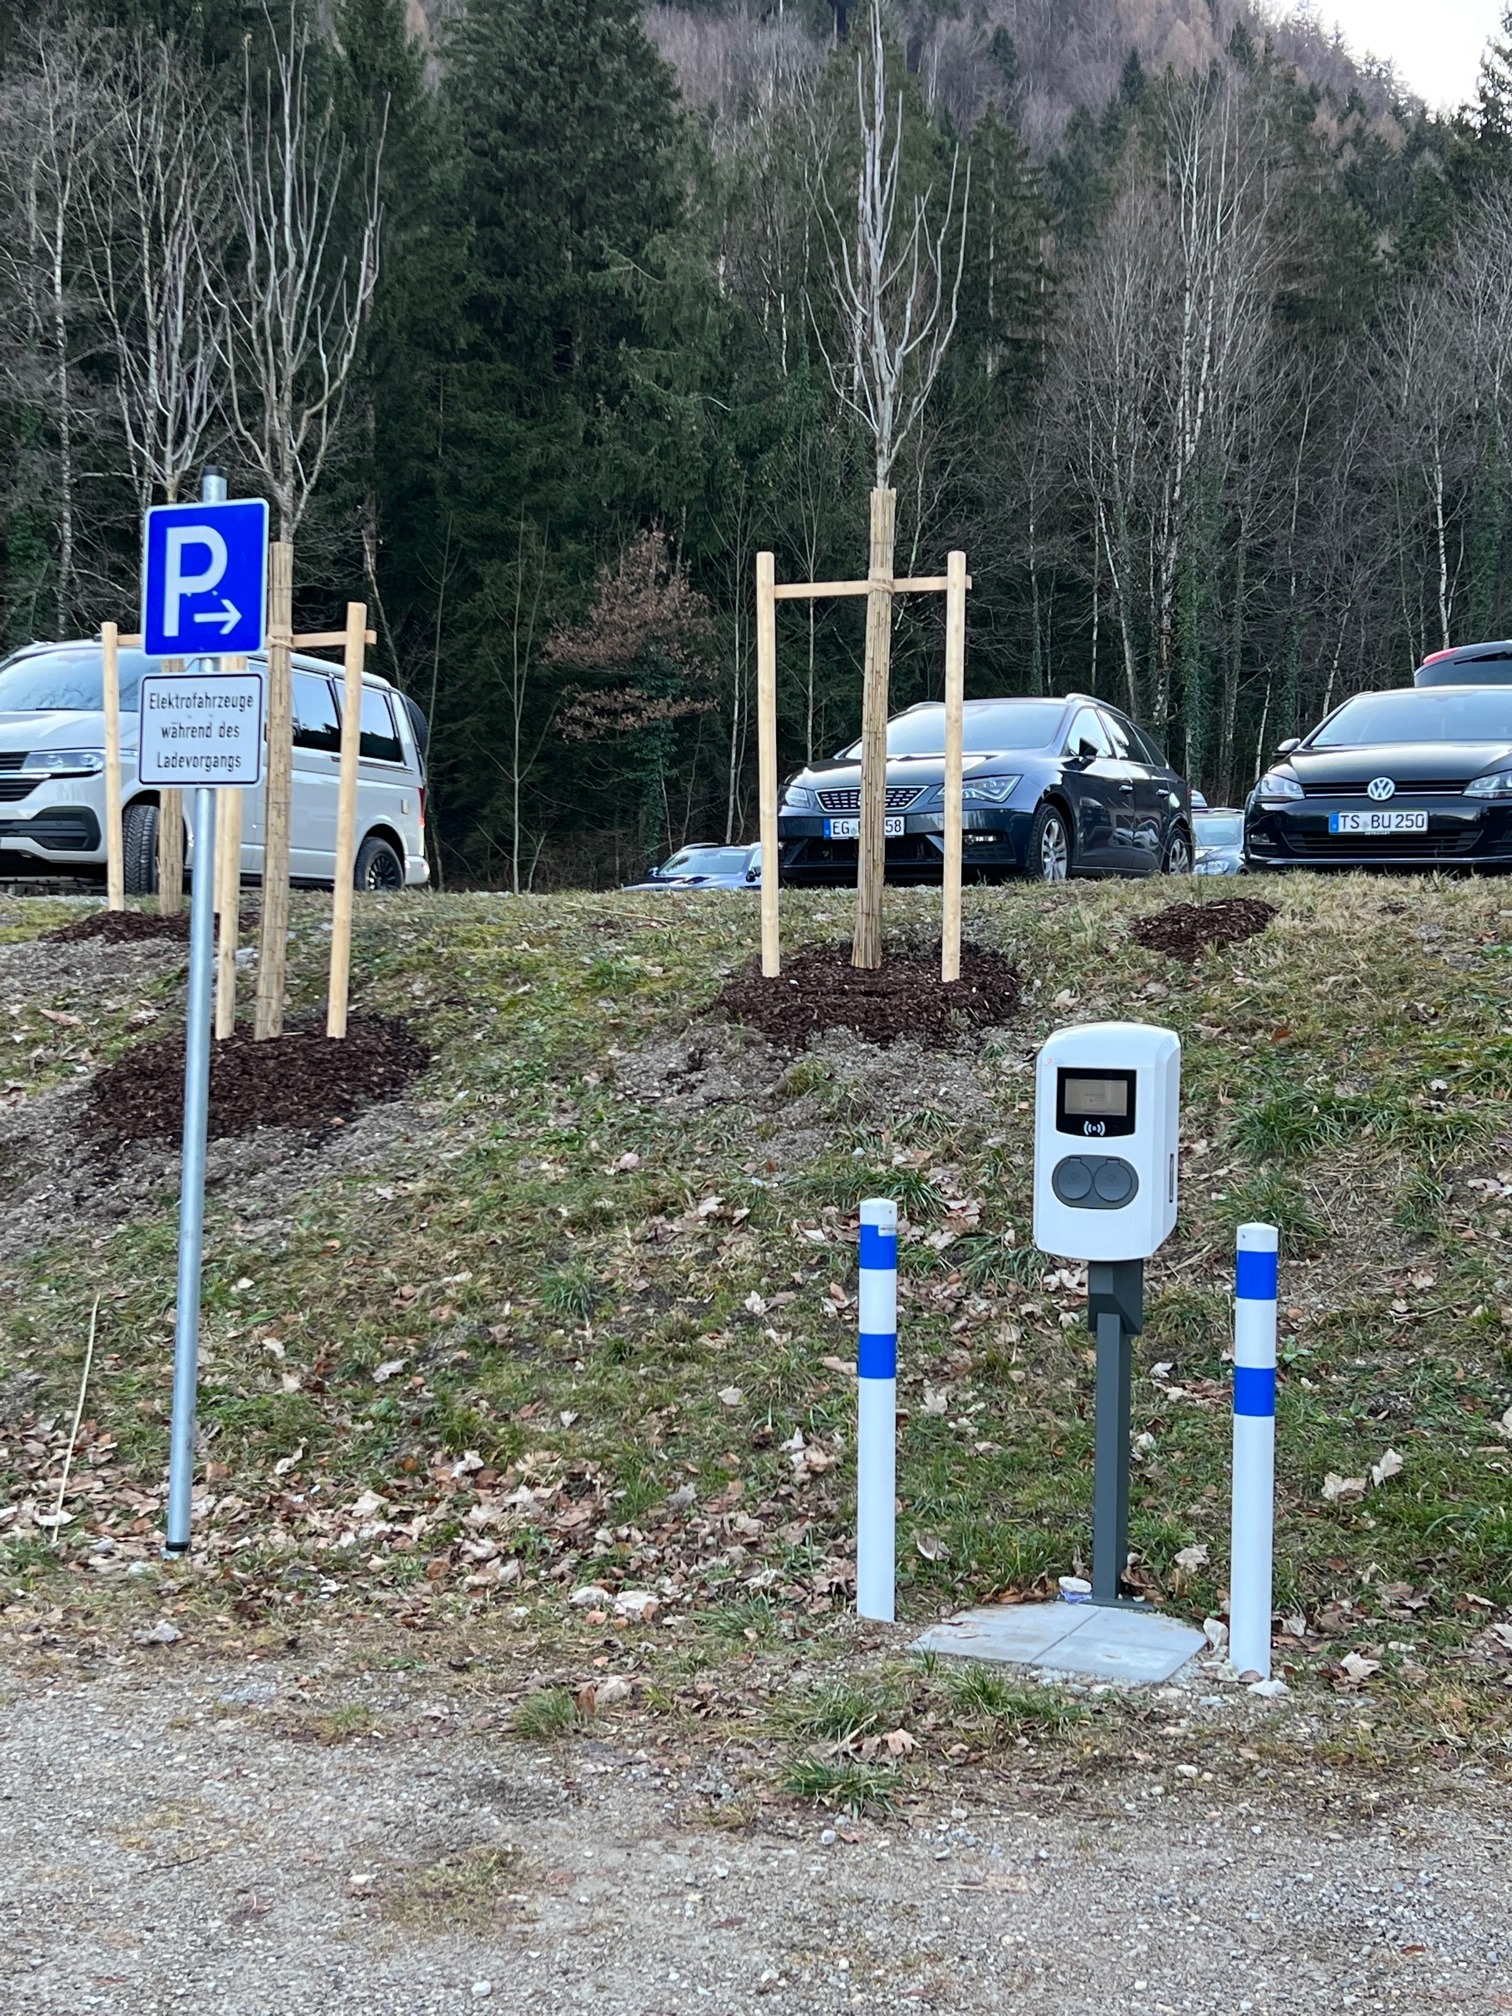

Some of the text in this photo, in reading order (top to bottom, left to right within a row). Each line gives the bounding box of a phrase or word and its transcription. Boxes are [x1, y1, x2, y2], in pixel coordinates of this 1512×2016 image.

[162, 525, 228, 637] P
[149, 692, 254, 712] Elektrofahrzeuge
[161, 721, 240, 739] während des
[157, 752, 242, 773] Ladevorgangs
[1368, 777, 1395, 801] VW
[833, 821, 850, 835] EG
[1340, 813, 1425, 830] TS BU 250
